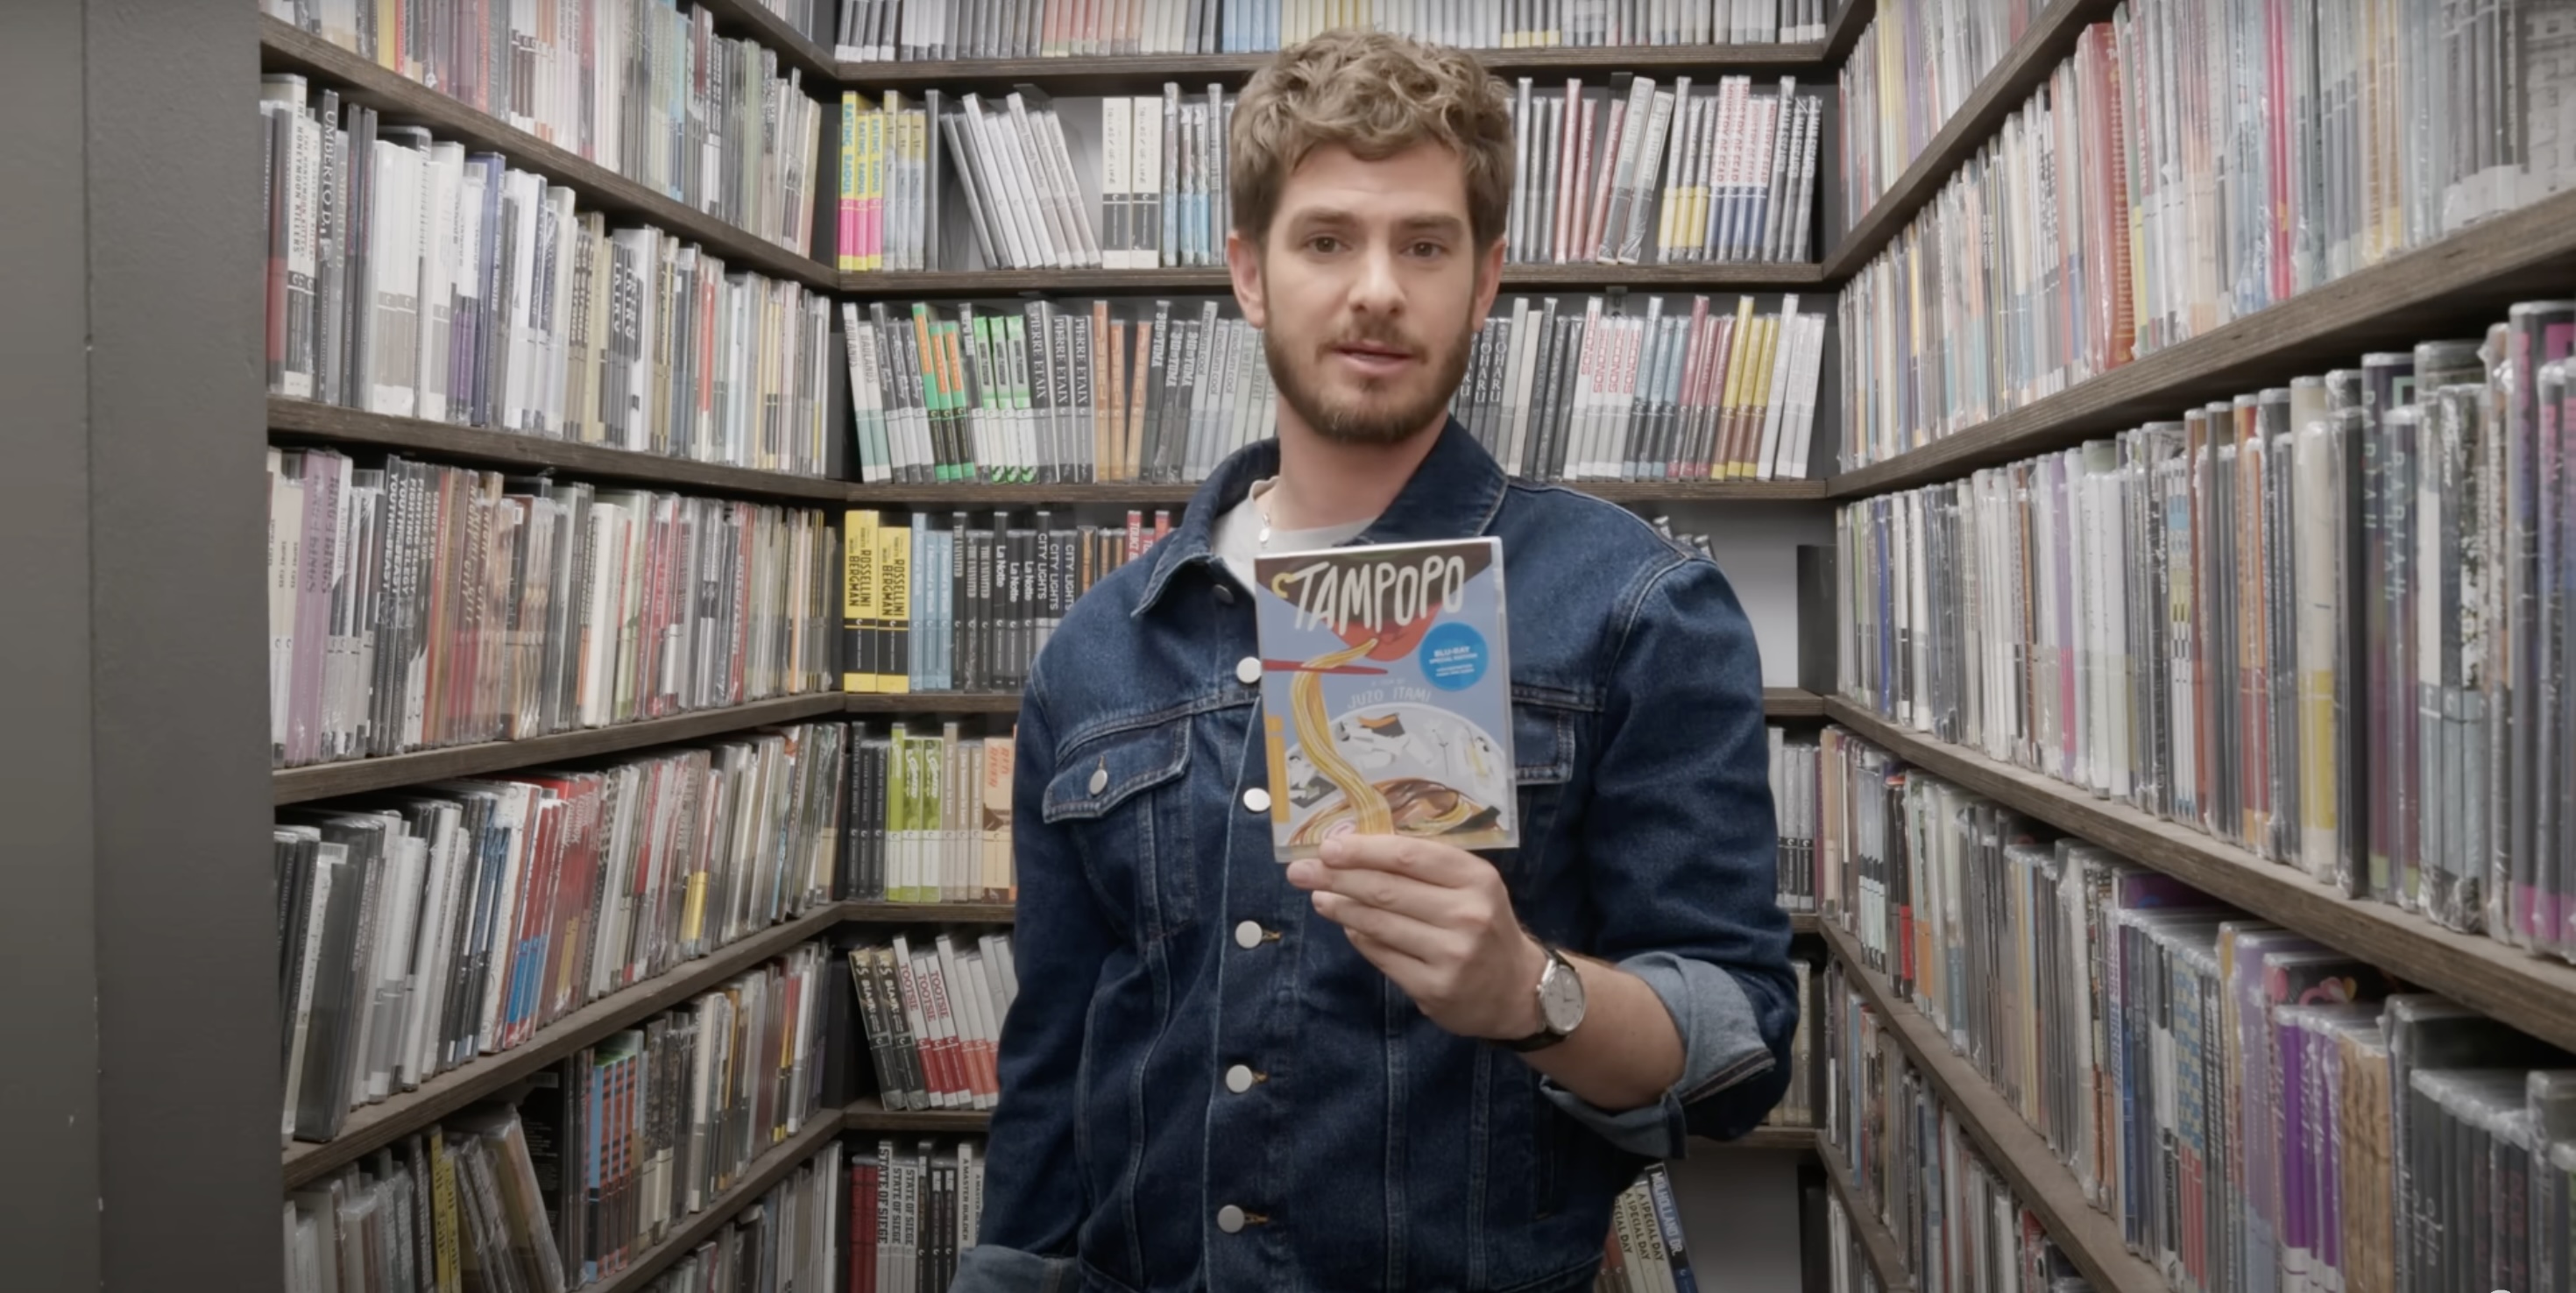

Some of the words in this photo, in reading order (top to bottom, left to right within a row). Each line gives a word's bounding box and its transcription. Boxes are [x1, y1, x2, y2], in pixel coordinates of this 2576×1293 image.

[841, 103, 853, 147] EATING
[857, 121, 867, 157] EATING
[294, 126, 303, 198] HONEYMOON
[322, 110, 336, 206] UMBERTO
[842, 154, 853, 194] RAOUL
[858, 162, 867, 194] RAOUL
[293, 204, 301, 252] KILLERS
[1030, 314, 1044, 357] PIERRE
[1054, 317, 1066, 362] PIERRE
[1075, 317, 1087, 362] PIERRE
[1198, 311, 1211, 351] medium
[1213, 329, 1225, 371] medium
[1228, 329, 1241, 370] medium
[1034, 360, 1047, 399] ETAIX
[1197, 353, 1207, 375] cool
[1475, 342, 1492, 404] OHARU
[1490, 341, 1508, 403] OHARU
[1593, 329, 1610, 393] SECONDS
[1608, 328, 1625, 393] SECONDS
[1623, 329, 1642, 394] SECONDS
[1055, 366, 1068, 403] ETAIX
[1076, 366, 1088, 403] ETAIX
[1209, 373, 1220, 395] cool
[1226, 371, 1235, 394] cool
[387, 473, 400, 526] YOUTH
[396, 478, 407, 530] YOUTH
[406, 477, 417, 546] FIGHTING
[414, 477, 425, 546] FIGHTING
[423, 491, 432, 533] CASQUE
[431, 491, 440, 532] CASQUE
[466, 484, 478, 535] NIGHT
[321, 536, 336, 594] KINGS
[383, 538, 393, 592] BEAST
[995, 544, 1007, 558] La
[1037, 532, 1048, 560] CITY
[1050, 543, 1060, 570] CITY
[1065, 543, 1075, 571] CITY
[392, 544, 403, 596] BEAST
[401, 548, 412, 596] ELEGY
[410, 548, 420, 595] ELEGY
[461, 560, 472, 597] CITY
[848, 555, 860, 607] BERGMAN
[859, 549, 873, 607] ROSSELLINI
[995, 559, 1007, 588] Notte
[1009, 561, 1021, 575] La
[1023, 560, 1035, 574] La
[1037, 562, 1048, 600] LIGHTS
[464, 587, 476, 624] CITY
[476, 584, 485, 622] CITY
[881, 565, 894, 617] BERGMAN
[893, 559, 906, 617] ROSSELLINI
[1009, 575, 1020, 603] Notte
[1023, 574, 1035, 602] Notte
[1049, 572, 1060, 611] LIGHTS
[1064, 573, 1075, 611] LIGHTS
[1272, 555, 1466, 637] TAMPOPO
[1433, 646, 1471, 658] BLU-RAY
[1346, 689, 1384, 710] JUZO
[1392, 685, 1433, 703] ITAMI
[987, 747, 999, 788] RIVER
[1001, 746, 1011, 774] RED
[900, 962, 919, 1011] TOOTSIE
[917, 972, 938, 1021] TOOTSIE
[931, 969, 950, 1019] TOOTSIE
[879, 1148, 890, 1189] STATE
[893, 1167, 902, 1200] STATE
[905, 1169, 916, 1202] STATE
[878, 1190, 889, 1206] OF
[892, 1201, 902, 1214] OF
[905, 1203, 915, 1216] OF
[1650, 1171, 1679, 1237] MULHOLLAND
[877, 1207, 888, 1245] SIEGE
[891, 1214, 902, 1244] SIEGE
[904, 1216, 915, 1246] SIEGE
[1620, 1234, 1634, 1254] DAY
[1626, 1200, 1645, 1240] SPECIAL
[1637, 1240, 1652, 1261] DAY
[1640, 1201, 1659, 1241] SPECIAL
[1651, 1241, 1666, 1261] DAY
